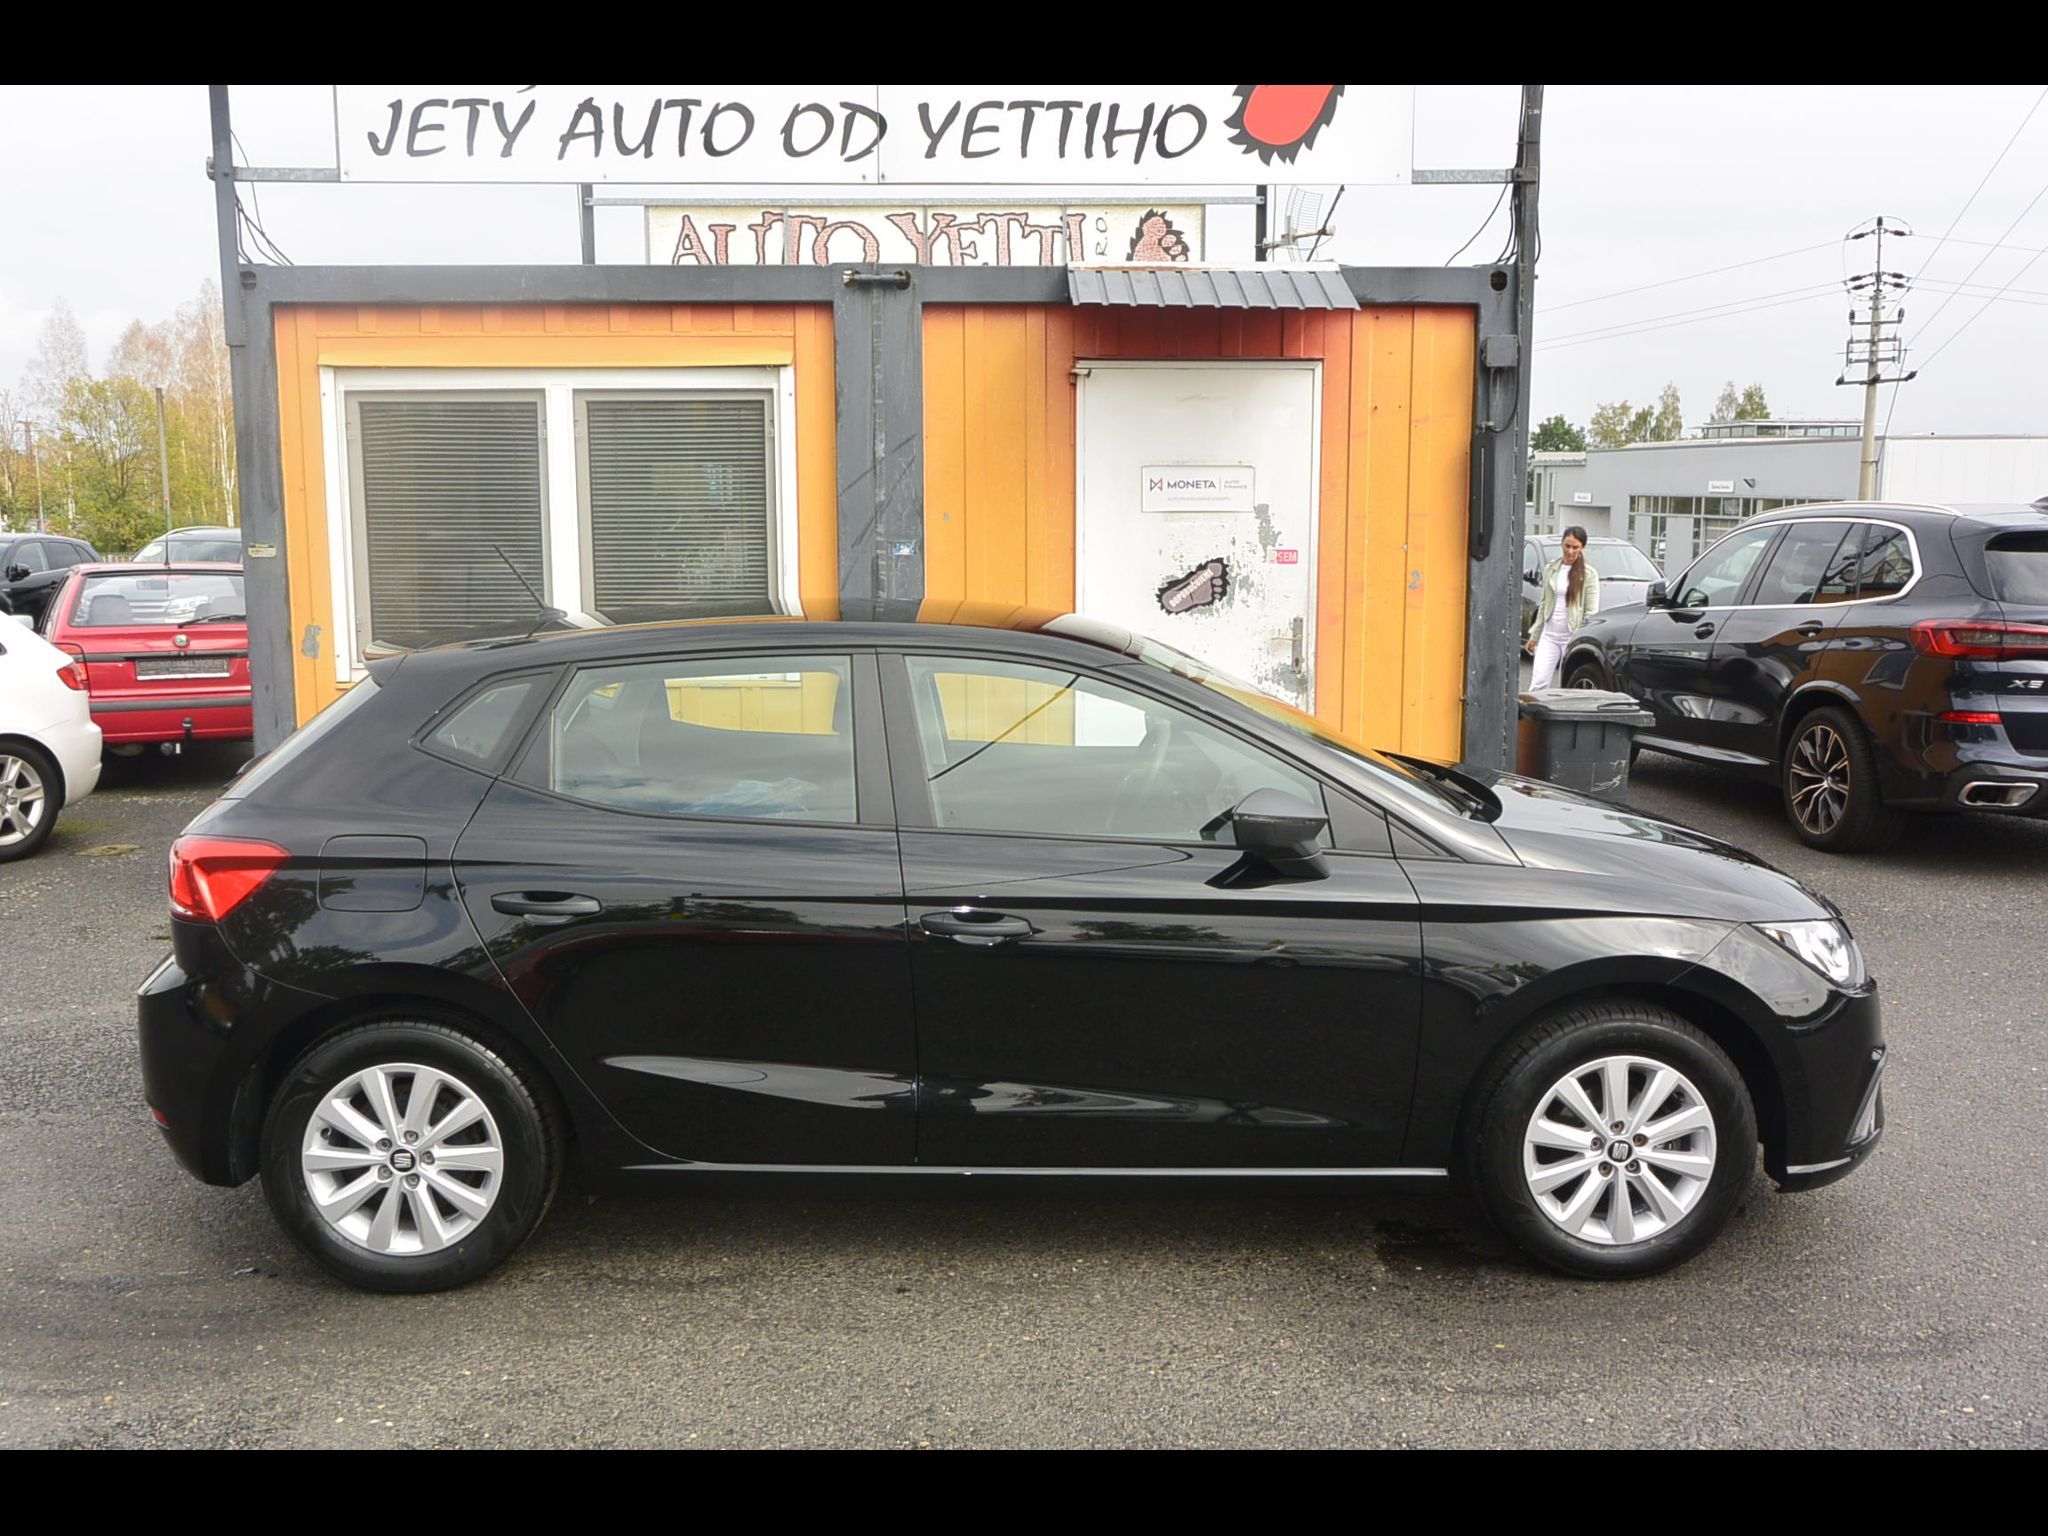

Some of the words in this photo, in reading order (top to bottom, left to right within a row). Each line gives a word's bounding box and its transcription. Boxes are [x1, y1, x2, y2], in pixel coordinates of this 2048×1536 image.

[557, 96, 756, 161] AUTO
[780, 101, 888, 163] OD
[917, 99, 1208, 165] YETTIHO
[1167, 479, 1217, 489] MONETA
[1278, 551, 1297, 562] SEM
[2007, 680, 2045, 688] X5
